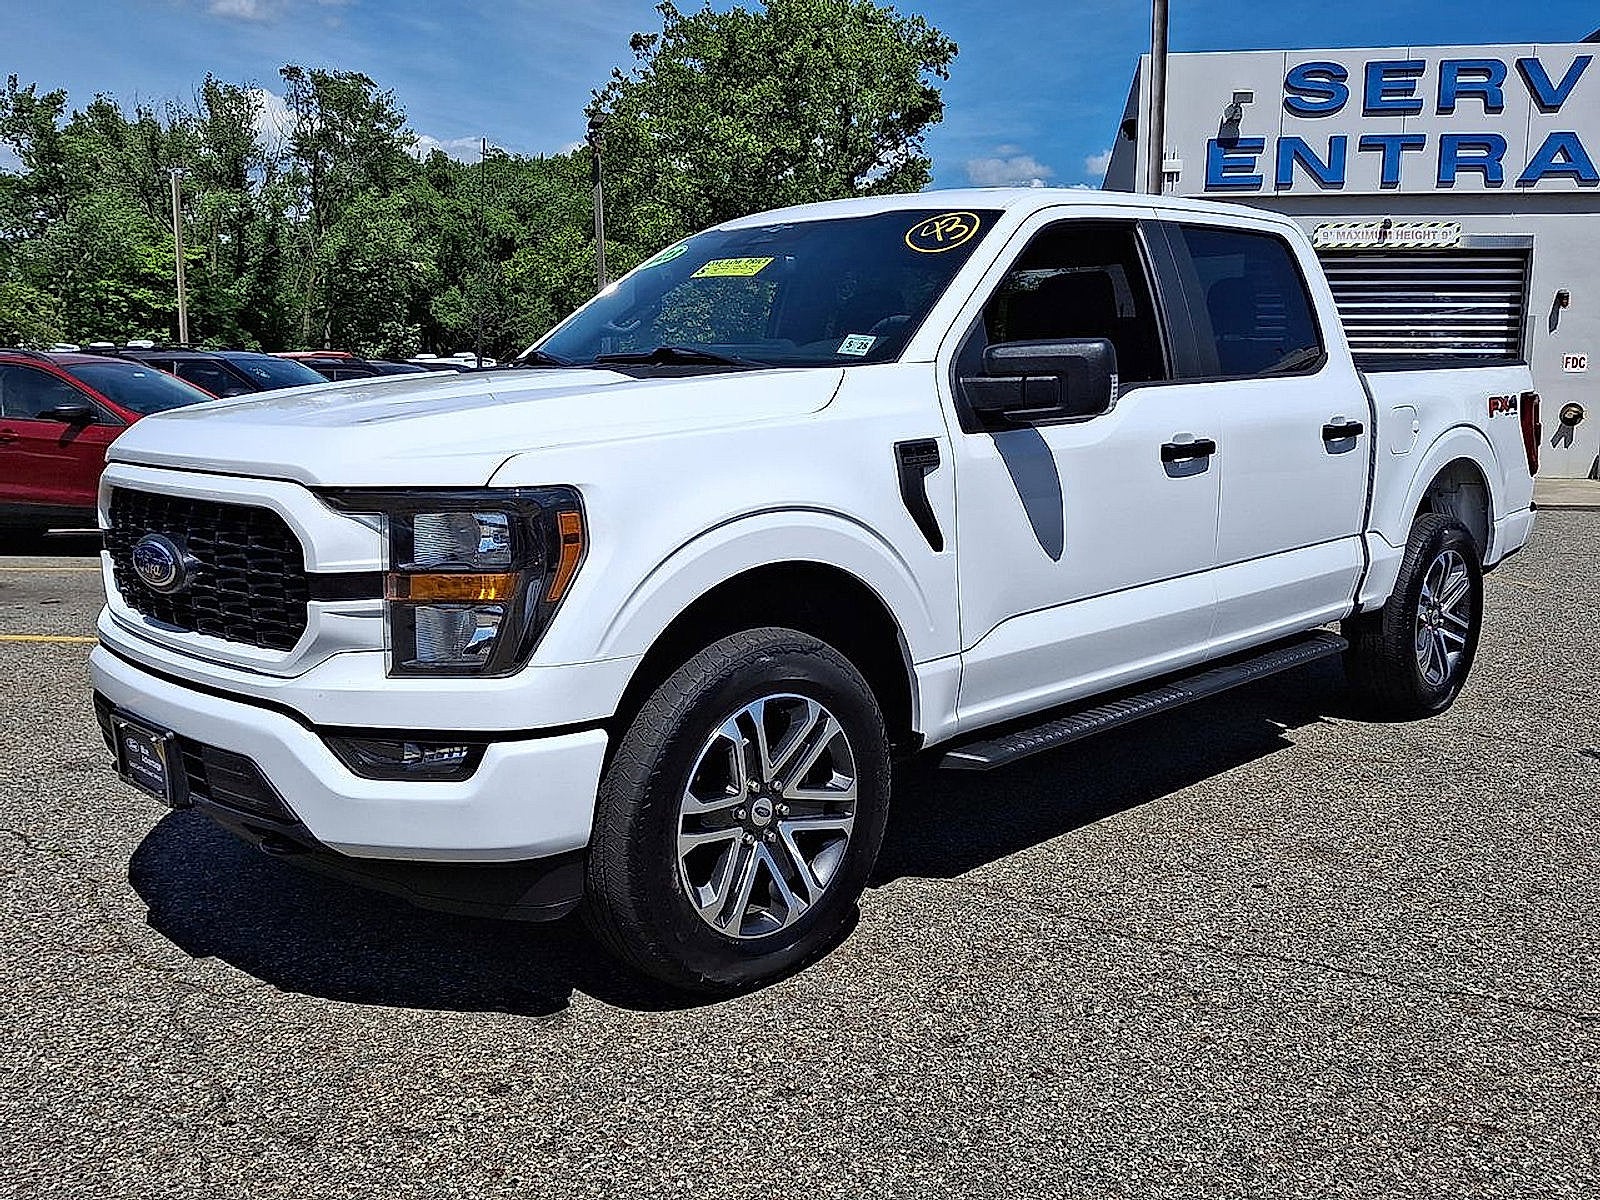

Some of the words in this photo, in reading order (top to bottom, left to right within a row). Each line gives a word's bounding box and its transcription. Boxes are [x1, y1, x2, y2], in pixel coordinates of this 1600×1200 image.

[1283, 55, 1593, 118] SERV
[1204, 131, 1600, 192] ENTRA
[921, 217, 969, 241] 43
[1336, 230, 1393, 240] MAXIMUM
[1395, 230, 1438, 240] HEIGHT
[1564, 356, 1586, 369] FDC
[1488, 395, 1518, 418] FX4
